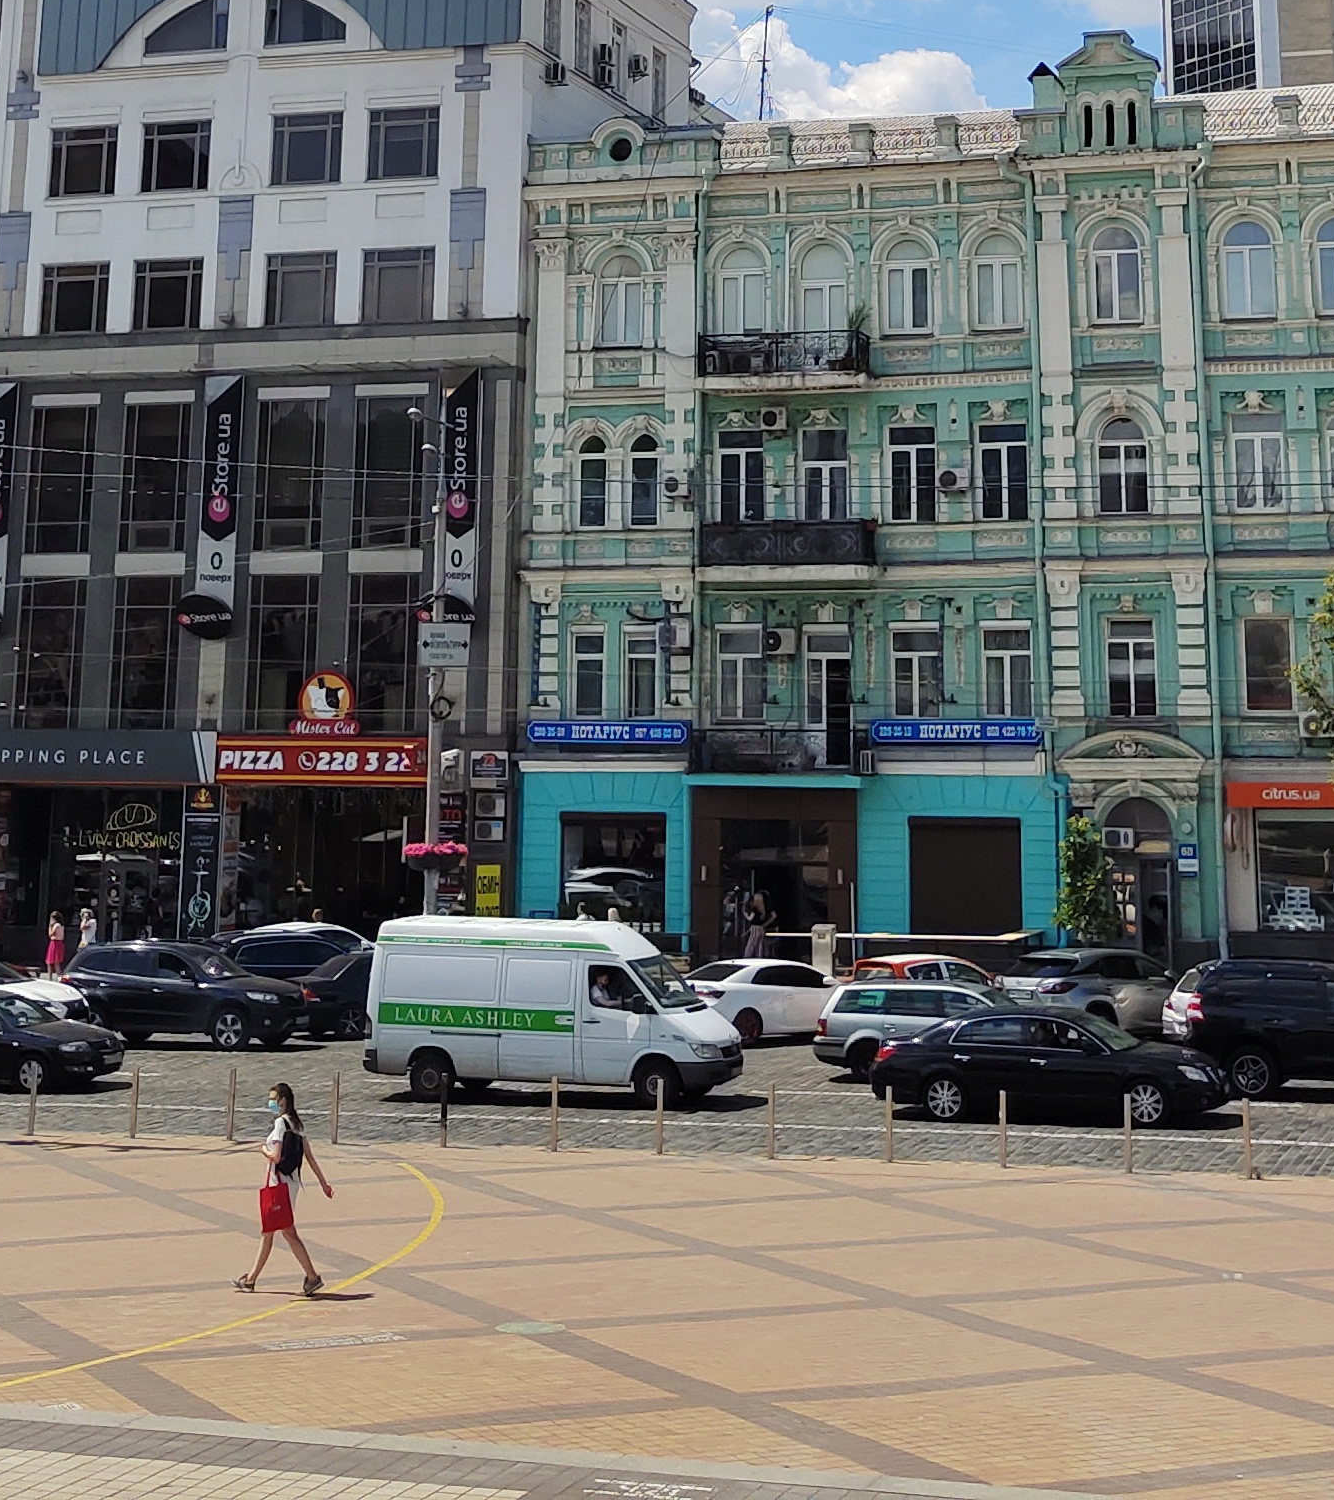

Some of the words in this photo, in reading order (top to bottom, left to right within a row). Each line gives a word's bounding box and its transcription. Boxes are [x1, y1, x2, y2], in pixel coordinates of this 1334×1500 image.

[290, 719, 331, 735] Mister
[333, 720, 356, 735] Cat
[79, 750, 146, 765] PLACE
[219, 750, 284, 771] PIZZA
[316, 751, 359, 771] 228
[364, 752, 379, 772] 3
[1261, 787, 1321, 800] citrus.ua
[394, 1006, 455, 1023] LAURA
[461, 1009, 536, 1028] ASHLEY
